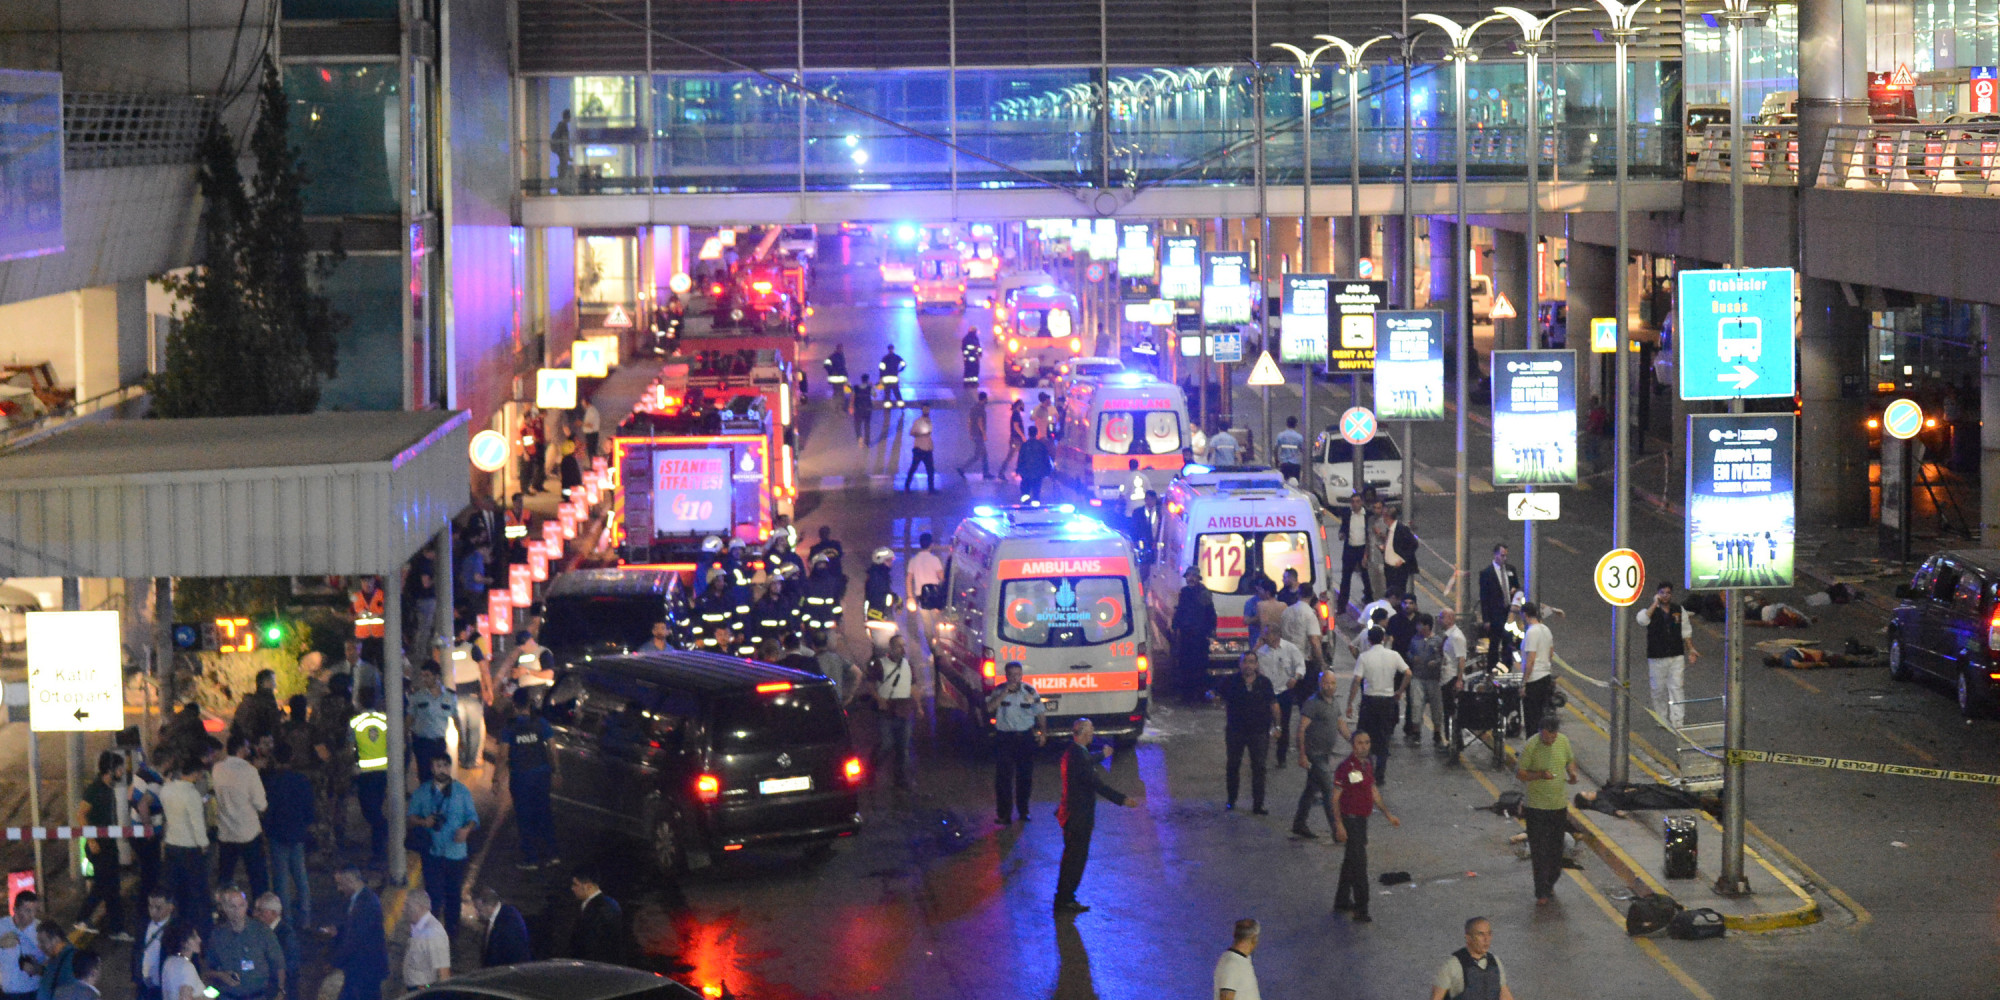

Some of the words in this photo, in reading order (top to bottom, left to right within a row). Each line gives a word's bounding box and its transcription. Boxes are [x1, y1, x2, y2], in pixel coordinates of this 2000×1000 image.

[1708, 278, 1768, 292] Otobüsler
[1712, 300, 1748, 313] Buses
[1332, 350, 1356, 359] RENT
[1356, 350, 1364, 359] A
[1103, 398, 1171, 410] AMBULANS
[677, 500, 713, 520] 110
[1207, 515, 1297, 529] AMBULANS
[1022, 560, 1101, 575] AMBULANS
[1201, 546, 1242, 577] 112
[1608, 565, 1637, 589] 30
[216, 618, 254, 653] 25
[1000, 645, 1027, 661] 112
[1109, 641, 1135, 657] 112
[1032, 677, 1067, 689] HIZIR
[1069, 674, 1098, 689] ACİL
